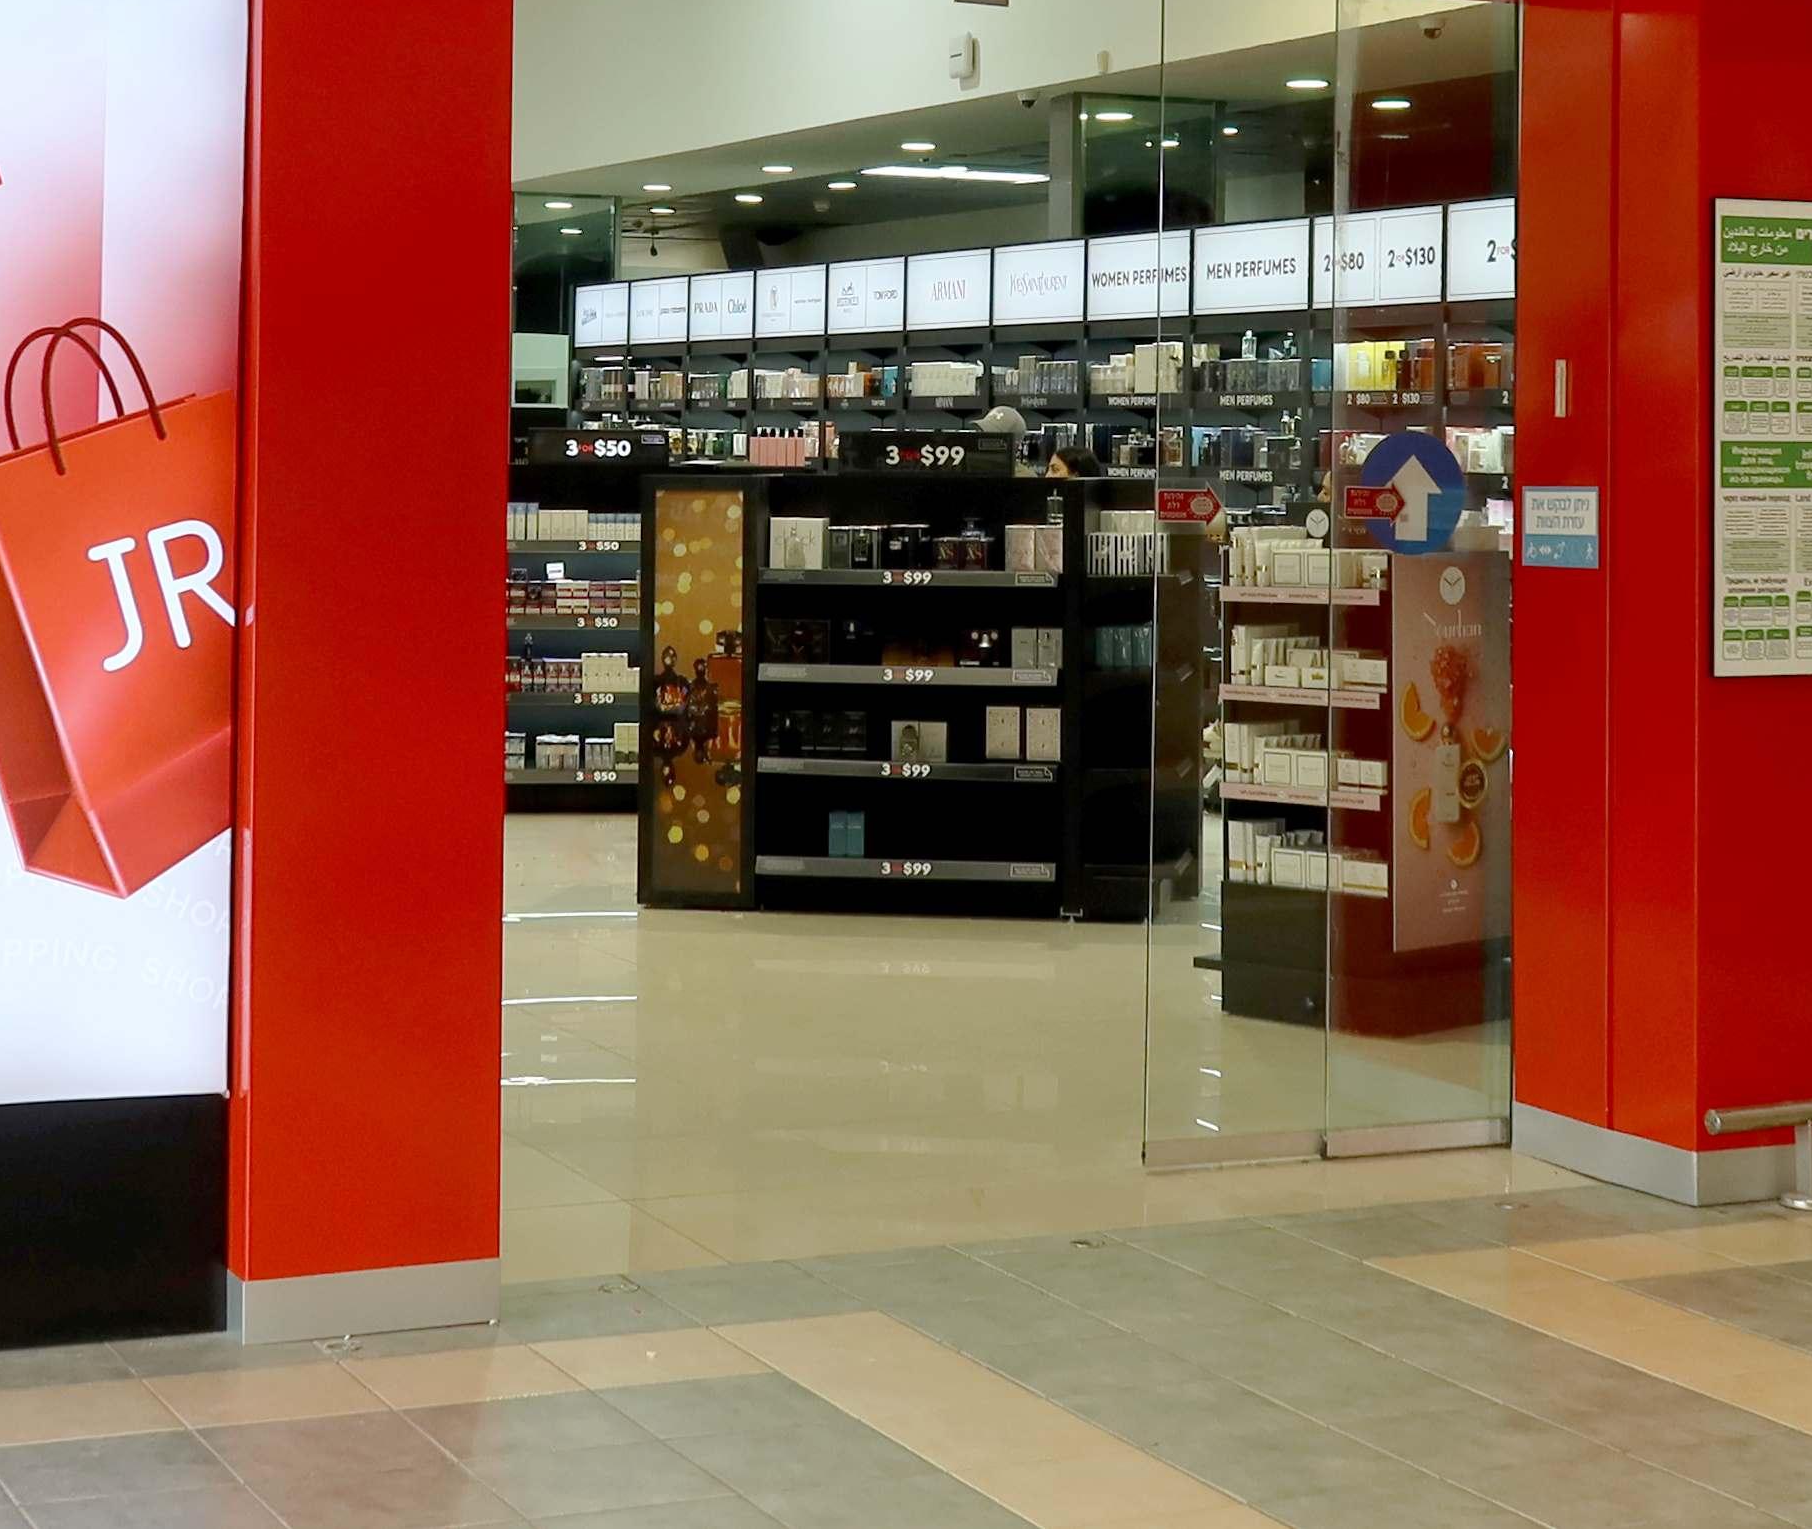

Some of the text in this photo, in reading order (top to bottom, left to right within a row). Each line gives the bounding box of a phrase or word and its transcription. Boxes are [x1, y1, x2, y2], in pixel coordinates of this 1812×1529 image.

[1387, 250, 1395, 268] 2
[1405, 246, 1436, 268] $130
[1486, 240, 1496, 263] 2
[1206, 257, 1297, 281] MEN PERFUMES
[1323, 252, 1365, 272] 2 $80
[1091, 271, 1129, 288] WOMEN
[930, 278, 967, 302] ARMANI
[693, 301, 718, 315] PRADA
[1130, 396, 1157, 407] PERFUME
[1219, 395, 1273, 406] MEN PERFUMES
[1502, 393, 1509, 404] 2
[565, 439, 579, 457] 3
[594, 438, 631, 458] $50
[885, 445, 900, 465] 3
[920, 444, 965, 467] $99
[1219, 470, 1273, 483] MEN PERFUMES
[1501, 476, 1509, 489] 2
[1795, 494, 1811, 502] Land
[578, 541, 619, 552] 3 $50
[883, 571, 932, 585] 3 $99
[86, 518, 237, 674] JR
[577, 617, 619, 628] 3 $50
[883, 668, 934, 682] 3 $99
[573, 693, 615, 704] 3 $50
[575, 771, 617, 782] 3 $50
[881, 763, 931, 777] 3 $99
[881, 862, 932, 876] 3 $99
